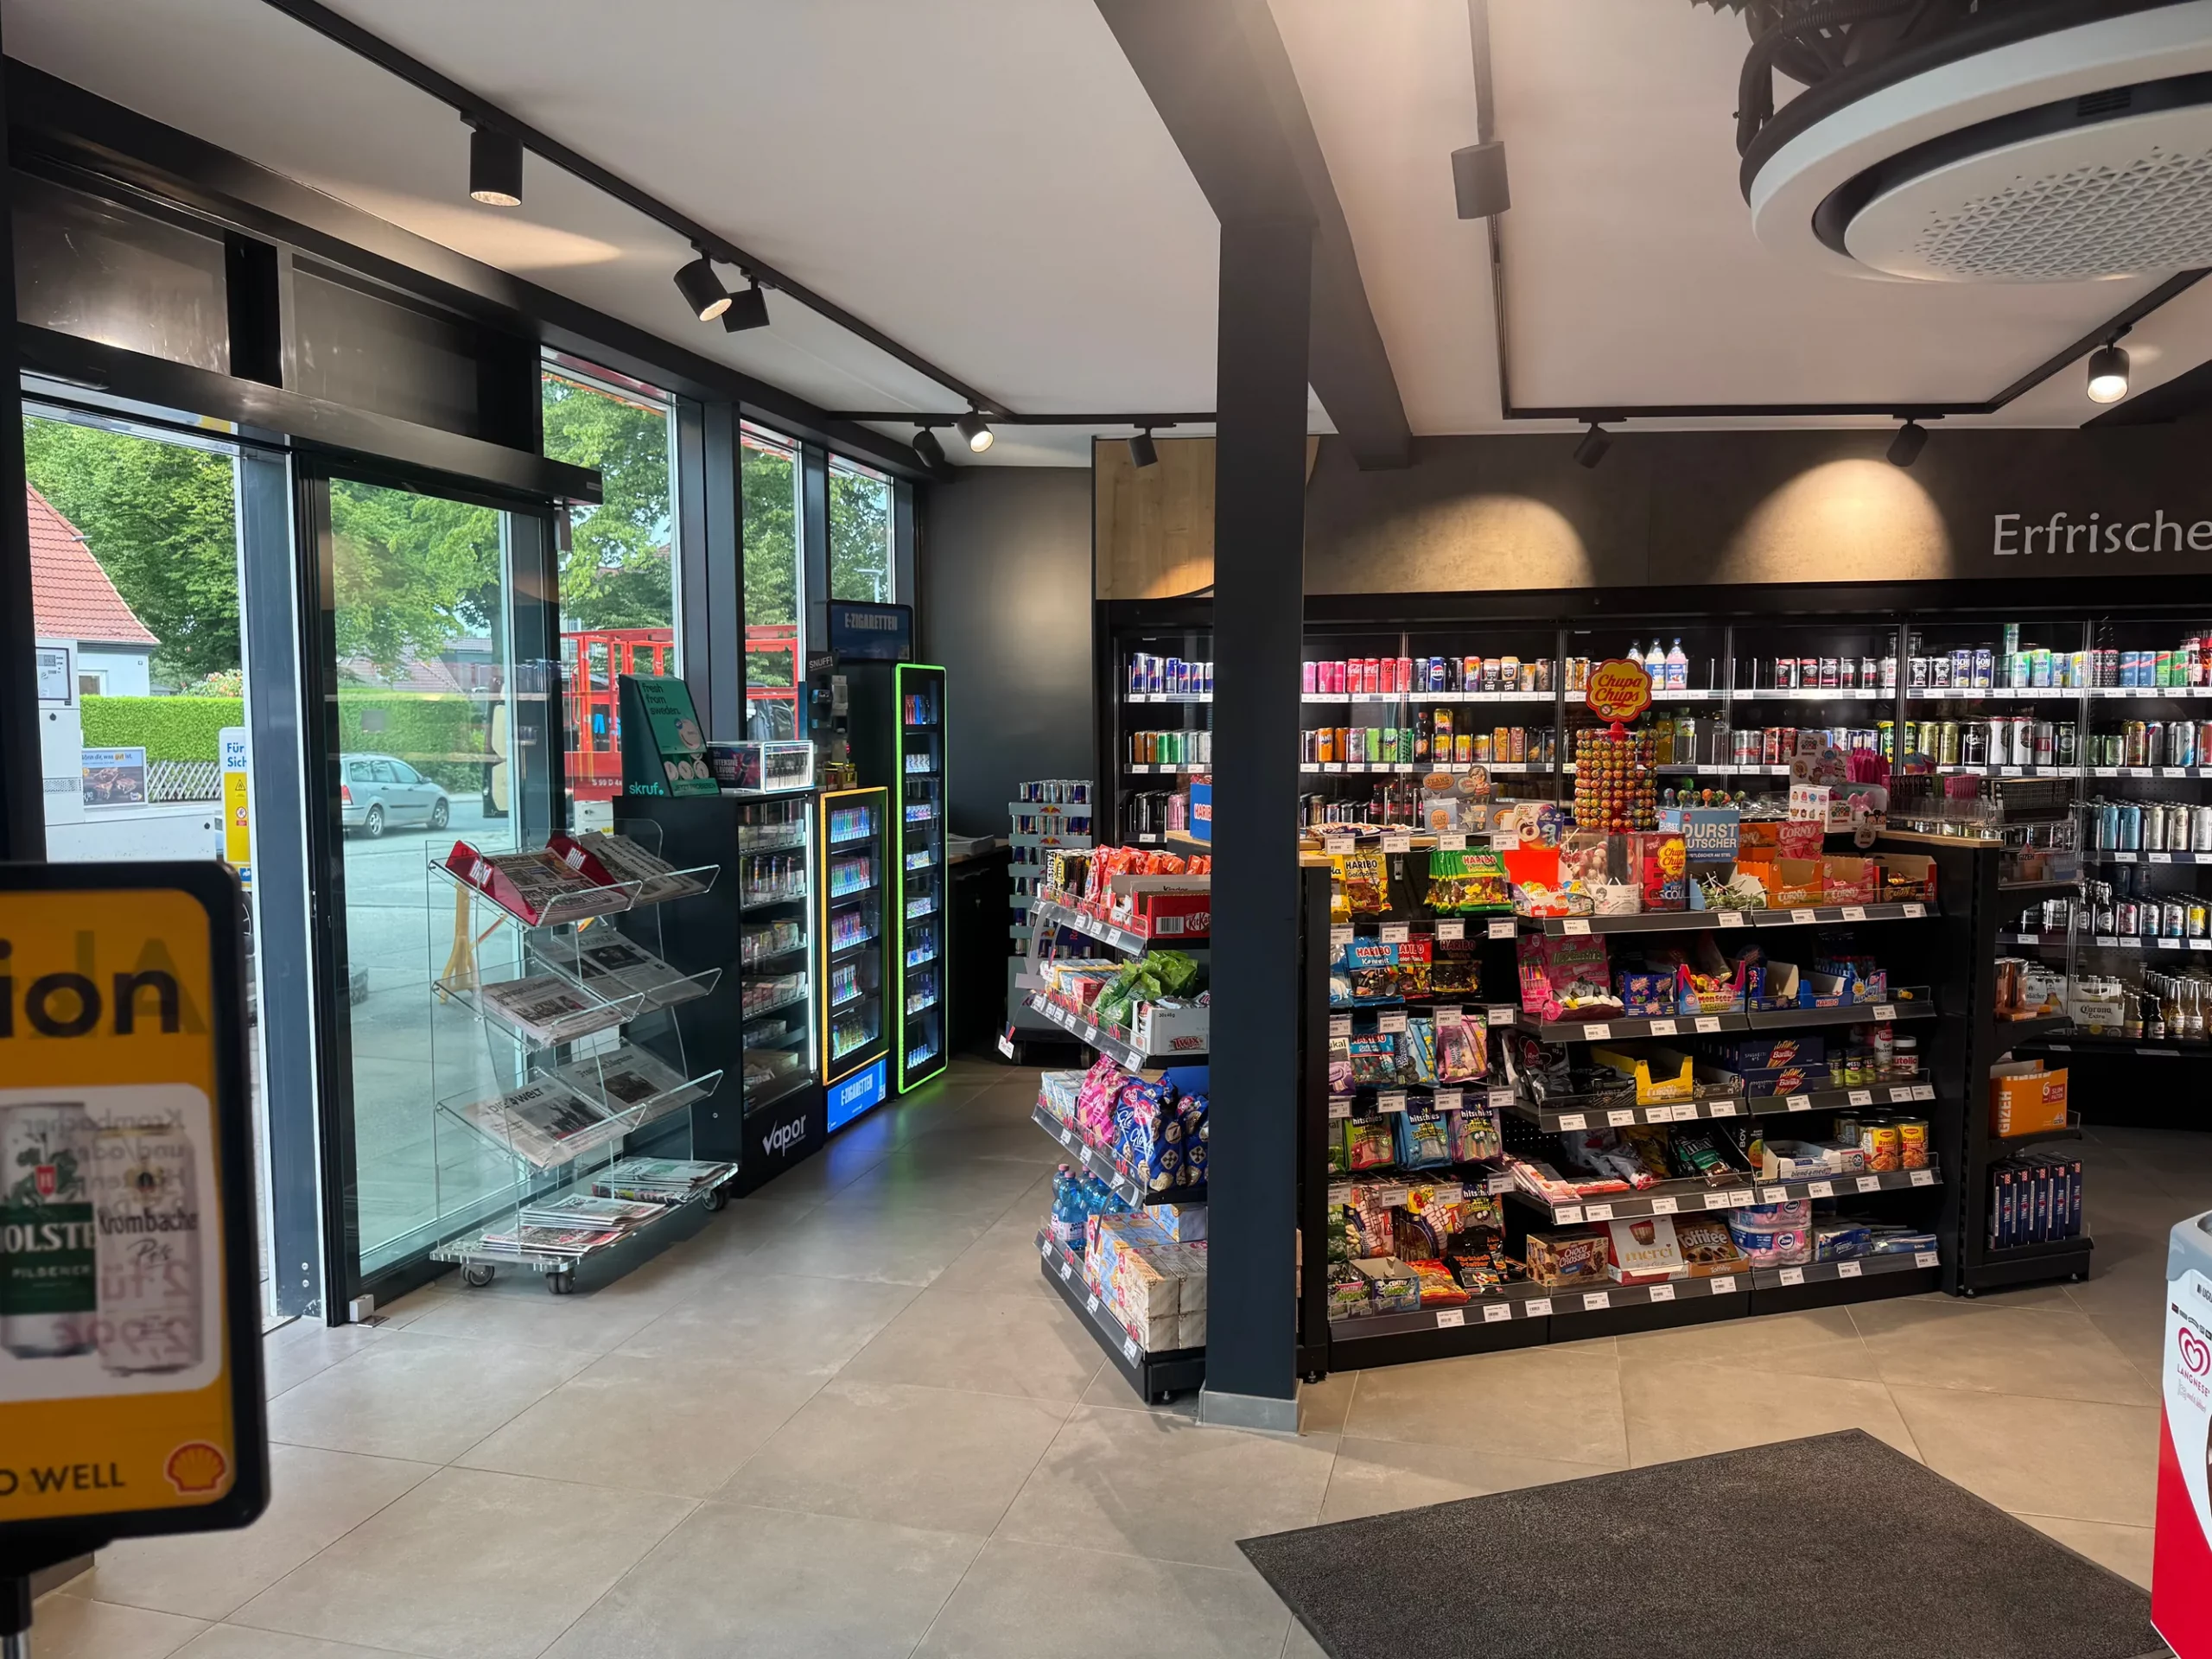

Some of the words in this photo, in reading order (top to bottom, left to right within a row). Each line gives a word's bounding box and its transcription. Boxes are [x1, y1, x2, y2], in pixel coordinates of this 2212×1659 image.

[1993, 509, 2212, 556] Erfrische
[844, 613, 898, 631] E-ZIGARETTEN
[809, 656, 833, 669] SNUFF!
[642, 683, 664, 693] fresh
[1598, 674, 1643, 690] Chupa
[645, 695, 666, 704] from
[1595, 690, 1639, 707] Chups
[651, 706, 681, 715] sweden.
[227, 743, 245, 753] Für
[1682, 823, 1738, 838] DURST
[1781, 825, 1815, 839] CORNY
[1345, 860, 1377, 869] HARIBO
[1462, 855, 1497, 865] HARIBO
[1356, 946, 1392, 957] HARIBO
[1440, 939, 1476, 950] HARIBO
[2081, 1006, 2112, 1015] Corona
[841, 1073, 874, 1106] E-ZIGARETTEN
[2043, 1082, 2050, 1096] 6
[1998, 1091, 2012, 1133] GIZEH
[1677, 1229, 1728, 1249] Toffifee
[1565, 1245, 1588, 1256] CHOCO
[1625, 1244, 1673, 1262] merci
[2177, 1363, 2209, 1397] LANGNESE
[30, 1463, 126, 1493] WELL
